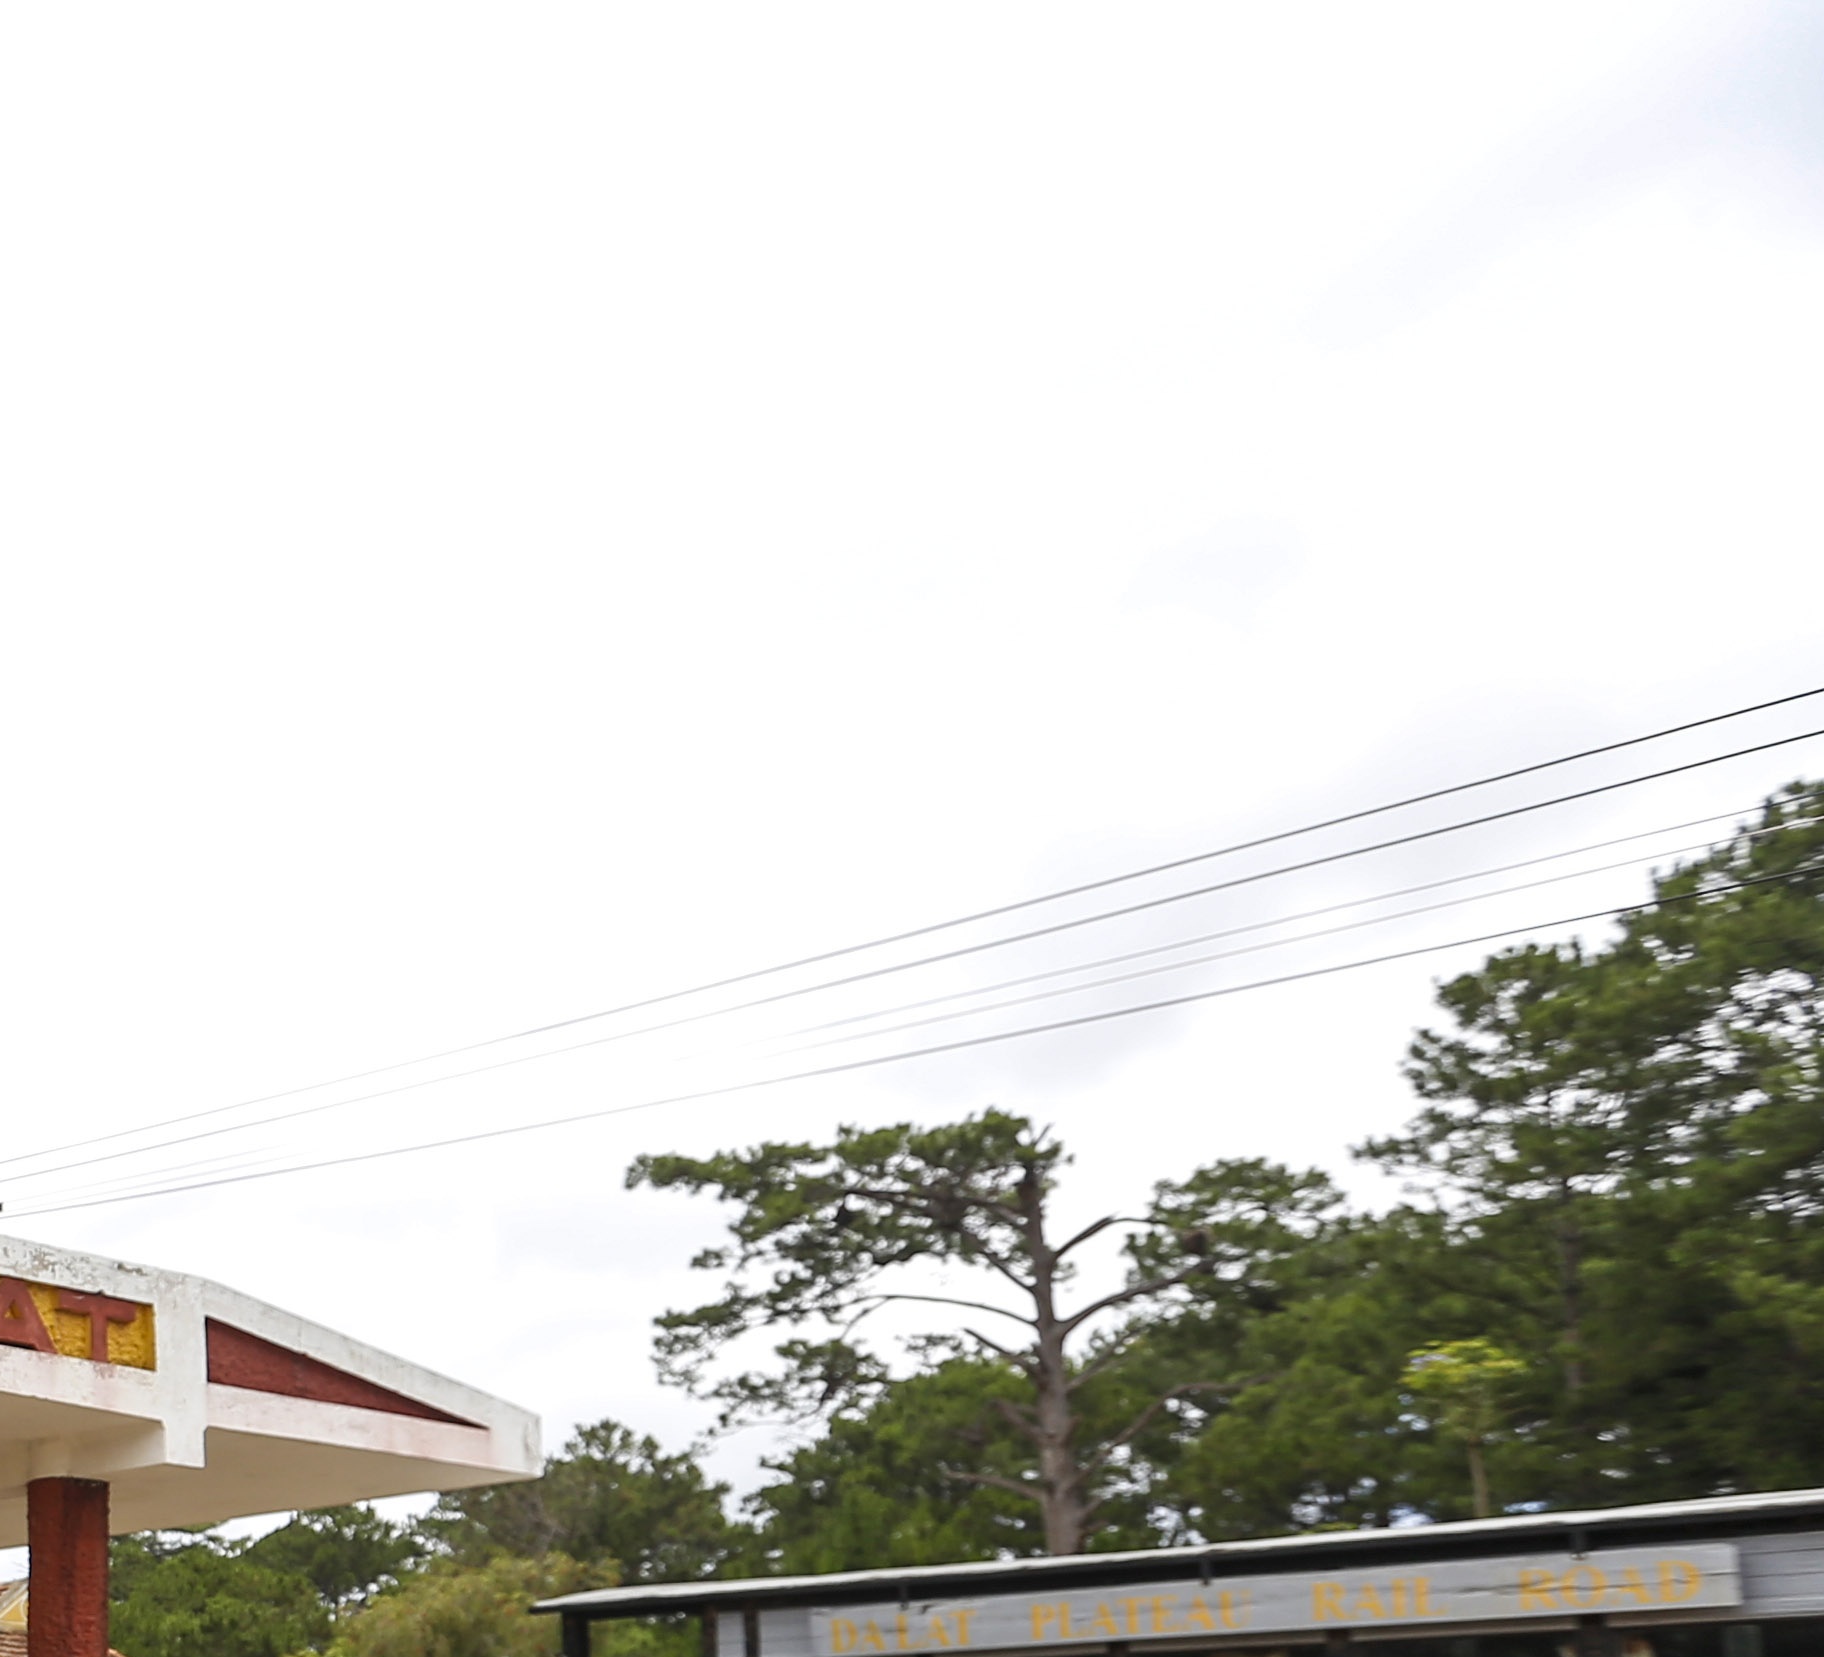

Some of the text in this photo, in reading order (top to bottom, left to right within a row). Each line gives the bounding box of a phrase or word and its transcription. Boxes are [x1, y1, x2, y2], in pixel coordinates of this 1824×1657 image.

[1030, 1589, 1252, 1640] PLATEAU
[1311, 1577, 1447, 1622] RAIL
[1518, 1559, 1701, 1611] ROAD
